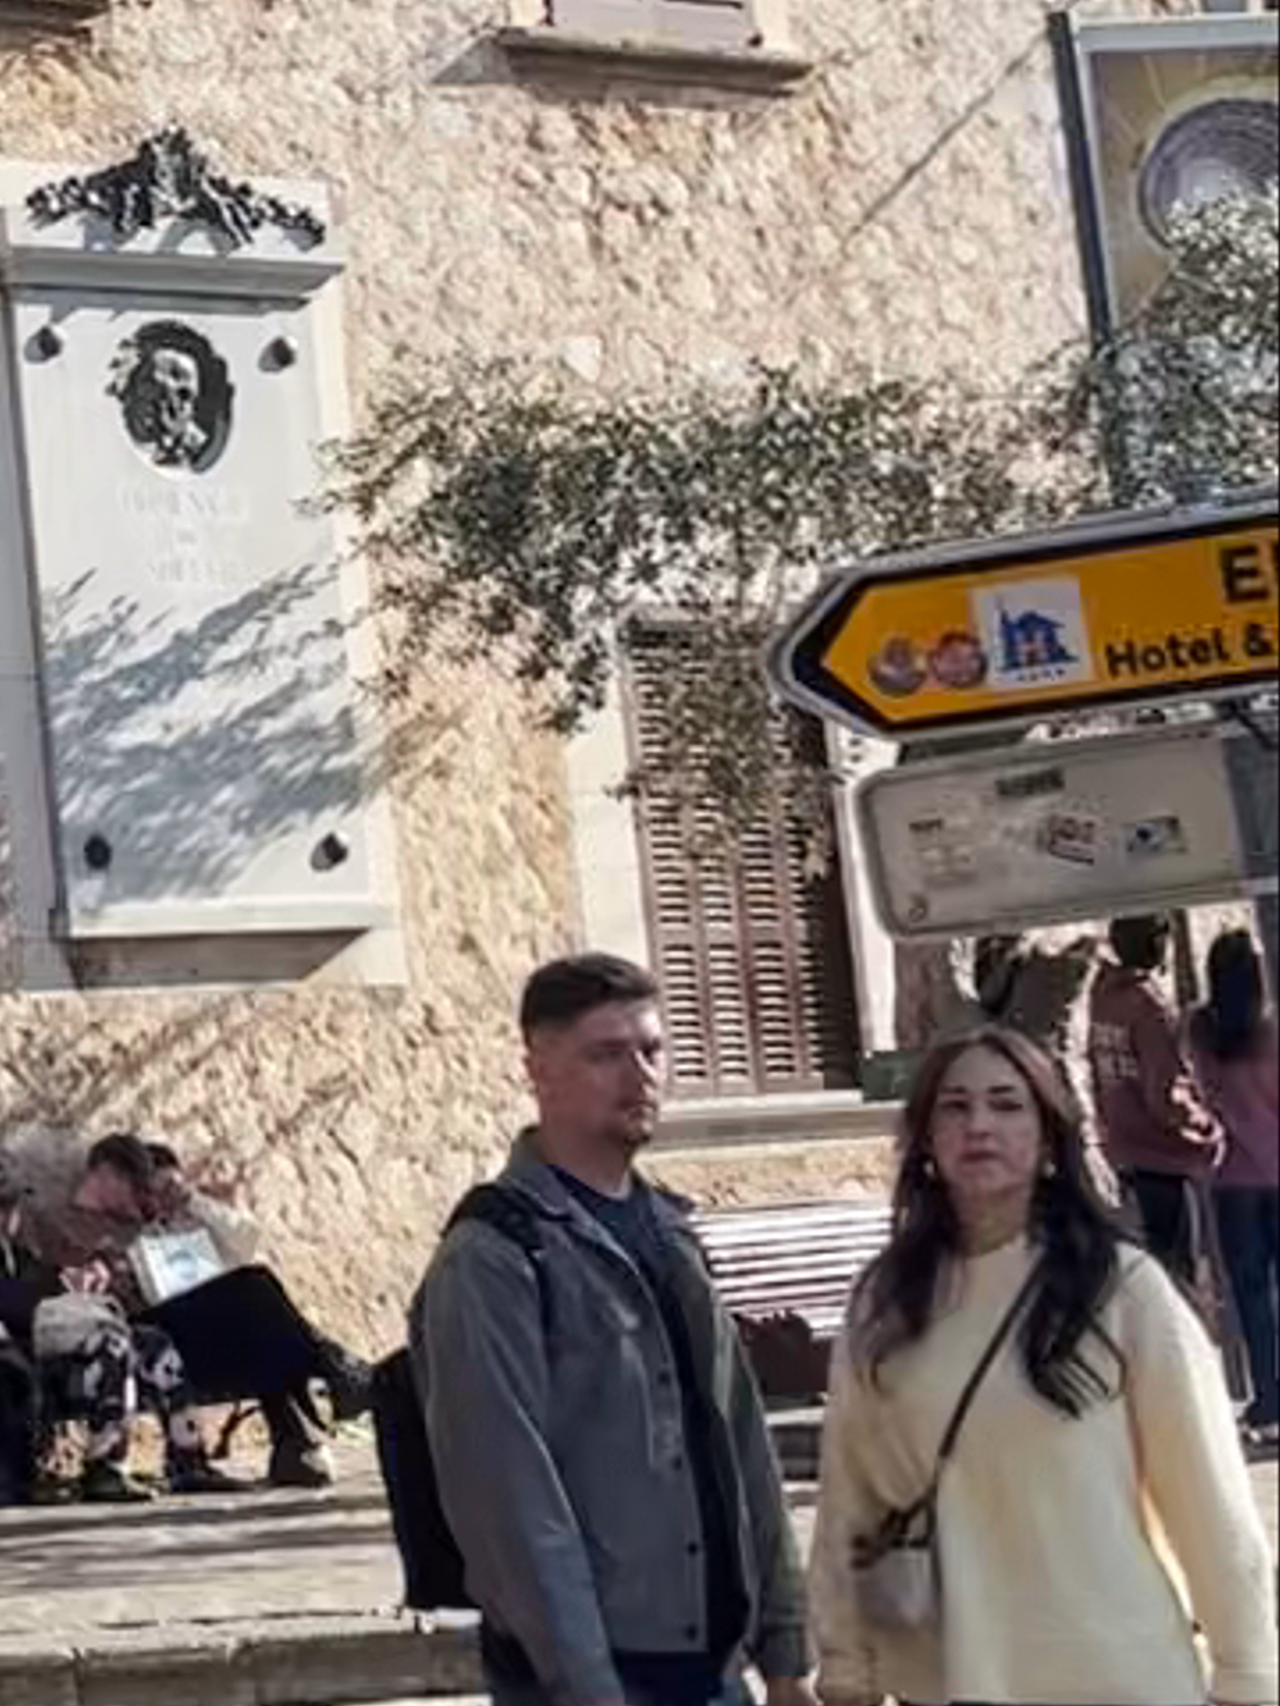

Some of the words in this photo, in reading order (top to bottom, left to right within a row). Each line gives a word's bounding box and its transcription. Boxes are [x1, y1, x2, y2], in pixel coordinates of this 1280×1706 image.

[1220, 542, 1278, 603] E
[1106, 627, 1230, 680] Hotel
[1244, 621, 1274, 658] &
